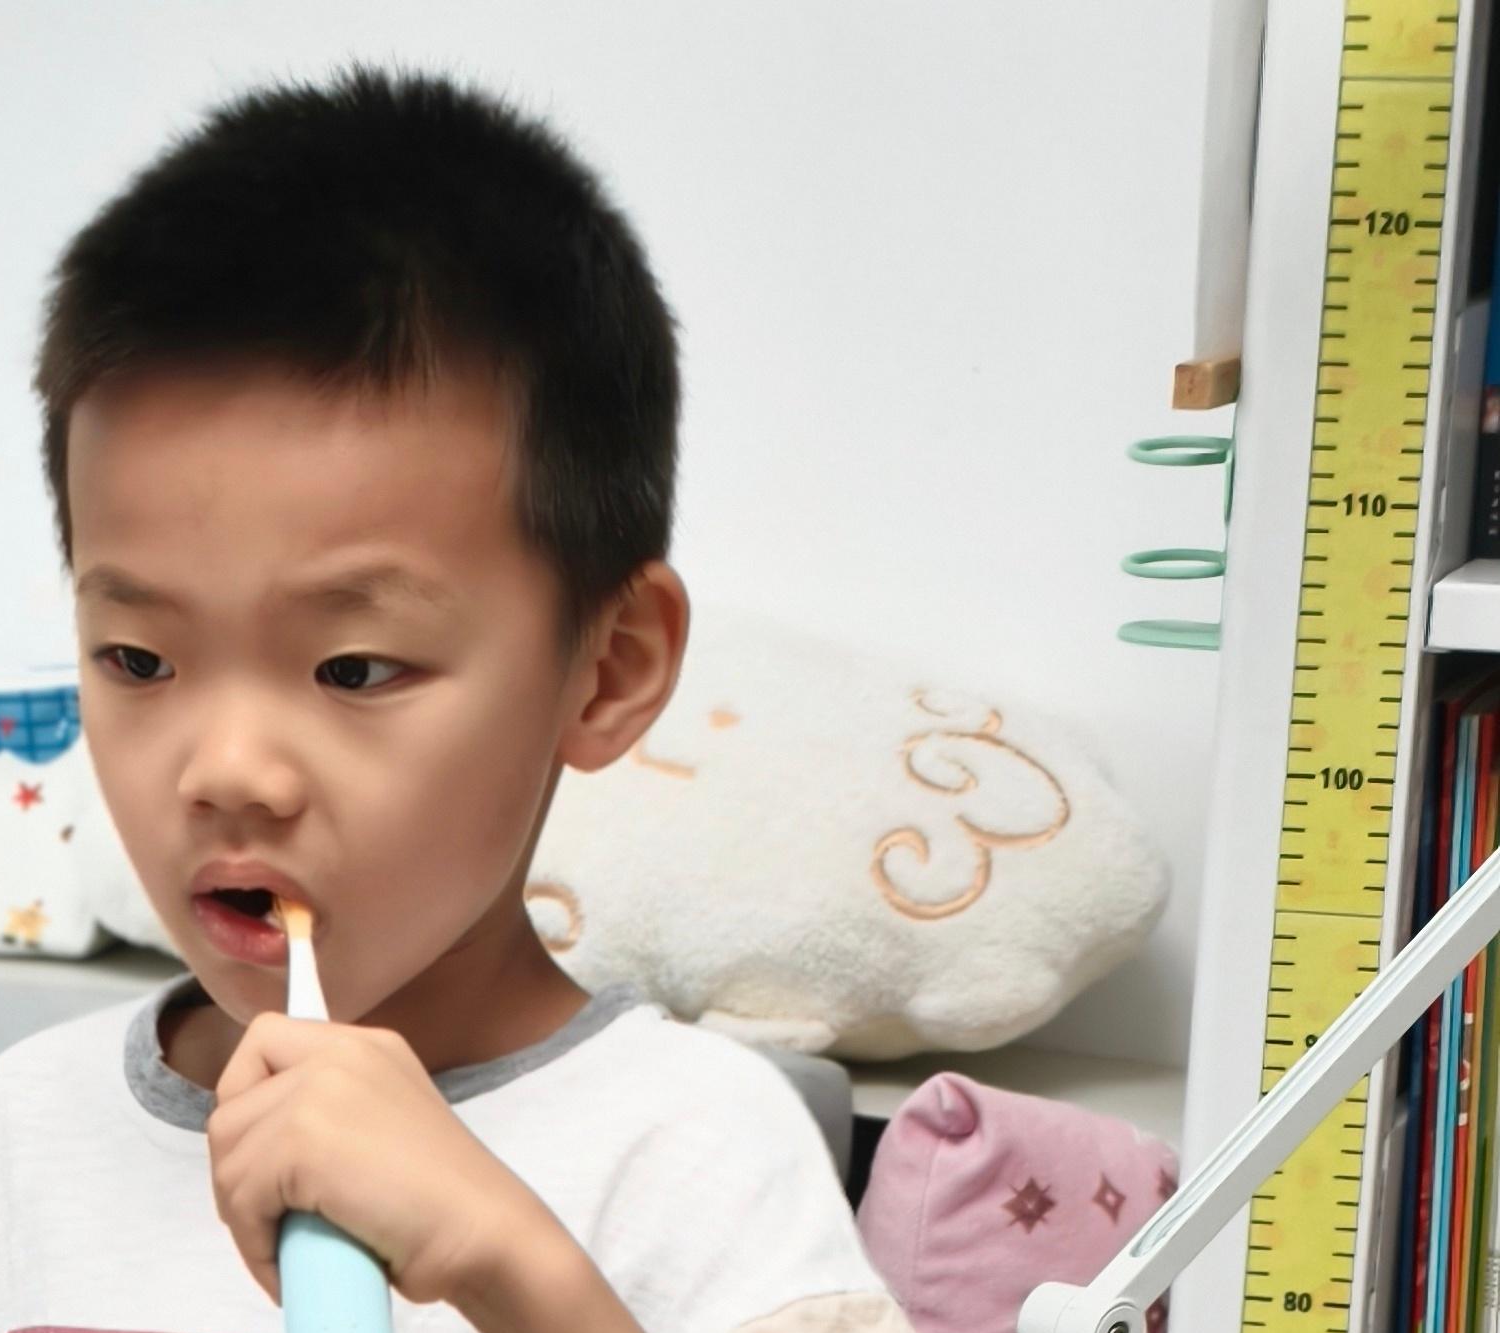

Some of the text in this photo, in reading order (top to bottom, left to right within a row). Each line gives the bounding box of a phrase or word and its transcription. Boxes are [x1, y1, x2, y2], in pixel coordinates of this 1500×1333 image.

[1365, 210, 1410, 236] 120
[1343, 493, 1386, 517] 110
[1320, 767, 1363, 791] 100
[1284, 1291, 1312, 1313] 80
